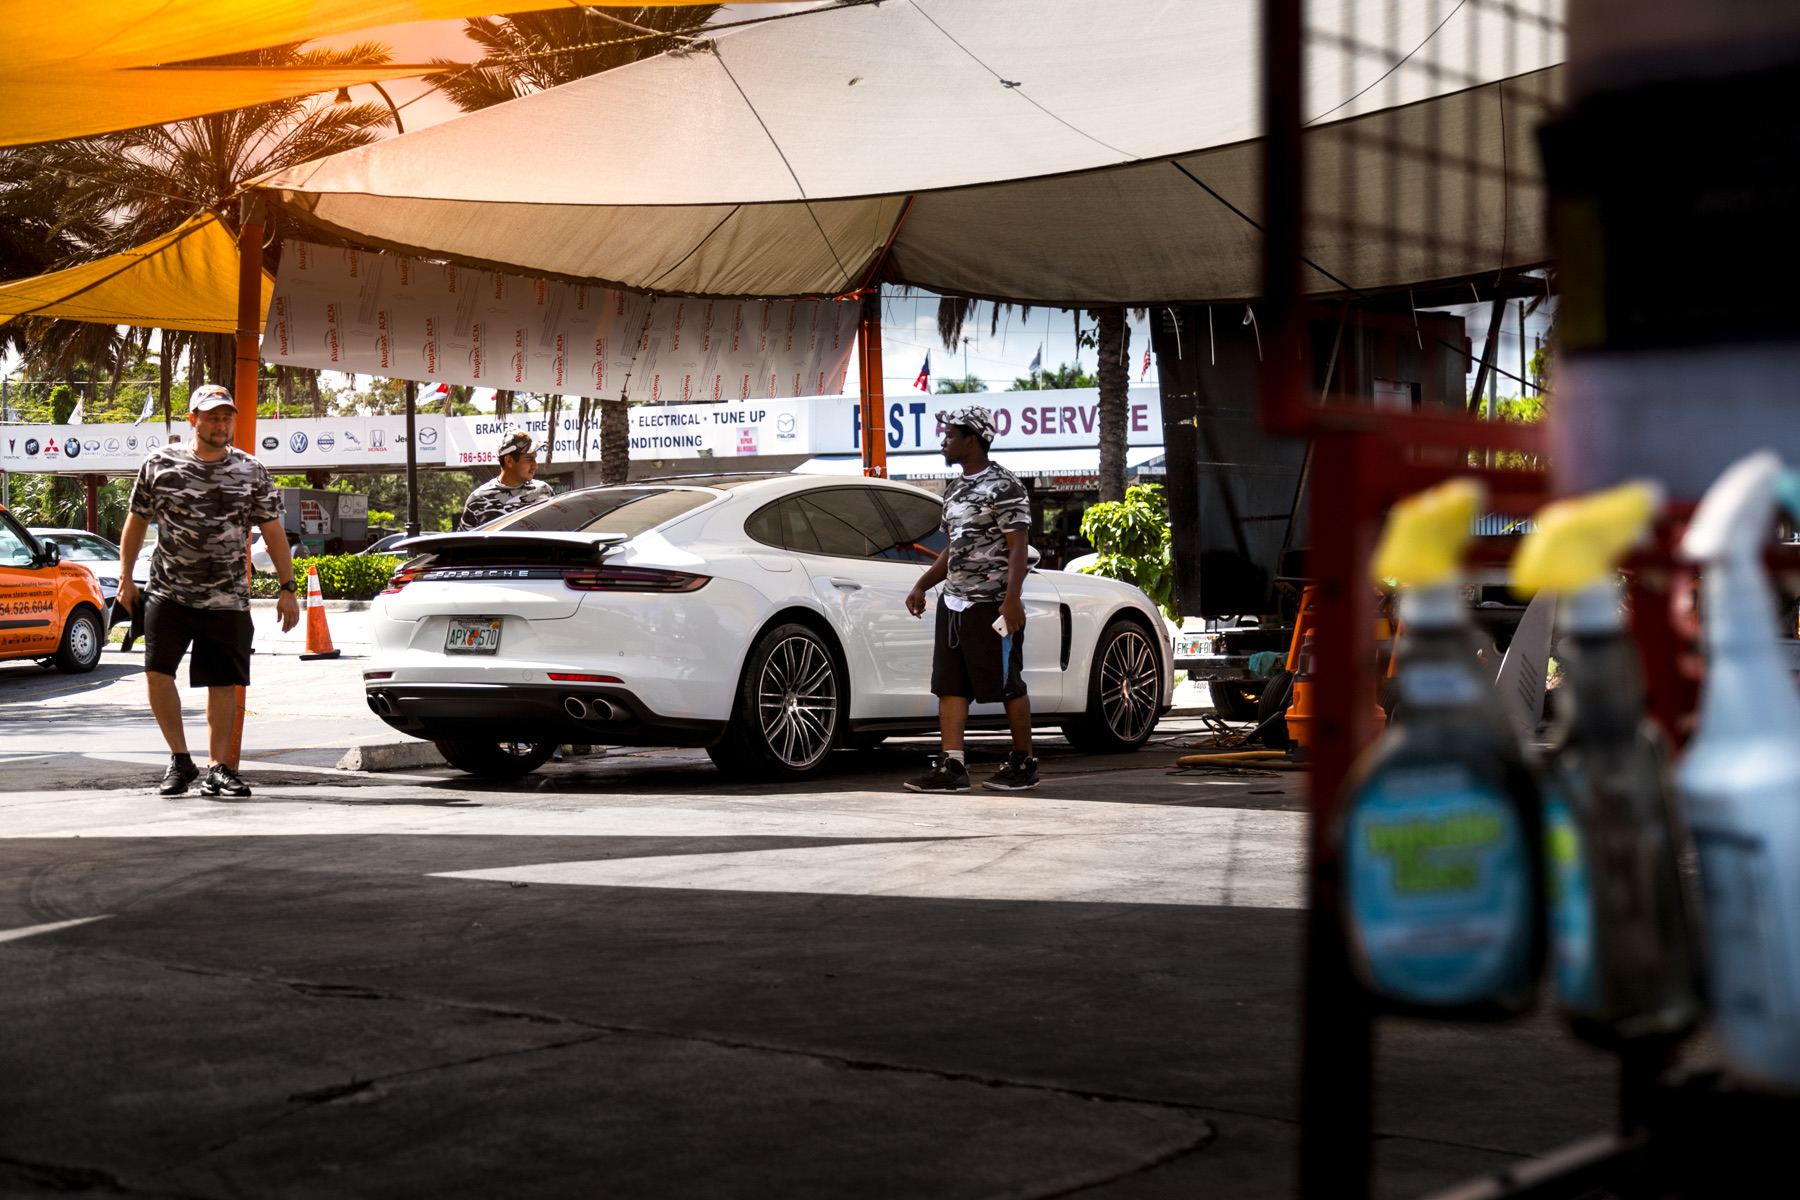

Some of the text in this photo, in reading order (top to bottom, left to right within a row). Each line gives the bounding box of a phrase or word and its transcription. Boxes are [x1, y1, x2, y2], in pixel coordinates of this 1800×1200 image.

[276, 297, 288, 355] Aluplast ACM
[327, 304, 339, 361] Aluplast ACM
[381, 335, 389, 368] Aluplast
[428, 341, 436, 373] Aluplast
[473, 346, 481, 378] Aluplast
[526, 420, 548, 432] TIRE
[639, 410, 766, 427] ELECTRICAL TUNE UP
[1021, 404, 1148, 436] SERVE
[628, 435, 703, 449] NDITIONING
[906, 472, 961, 480] ELECTRICA
[435, 570, 529, 578] PORSCHE
